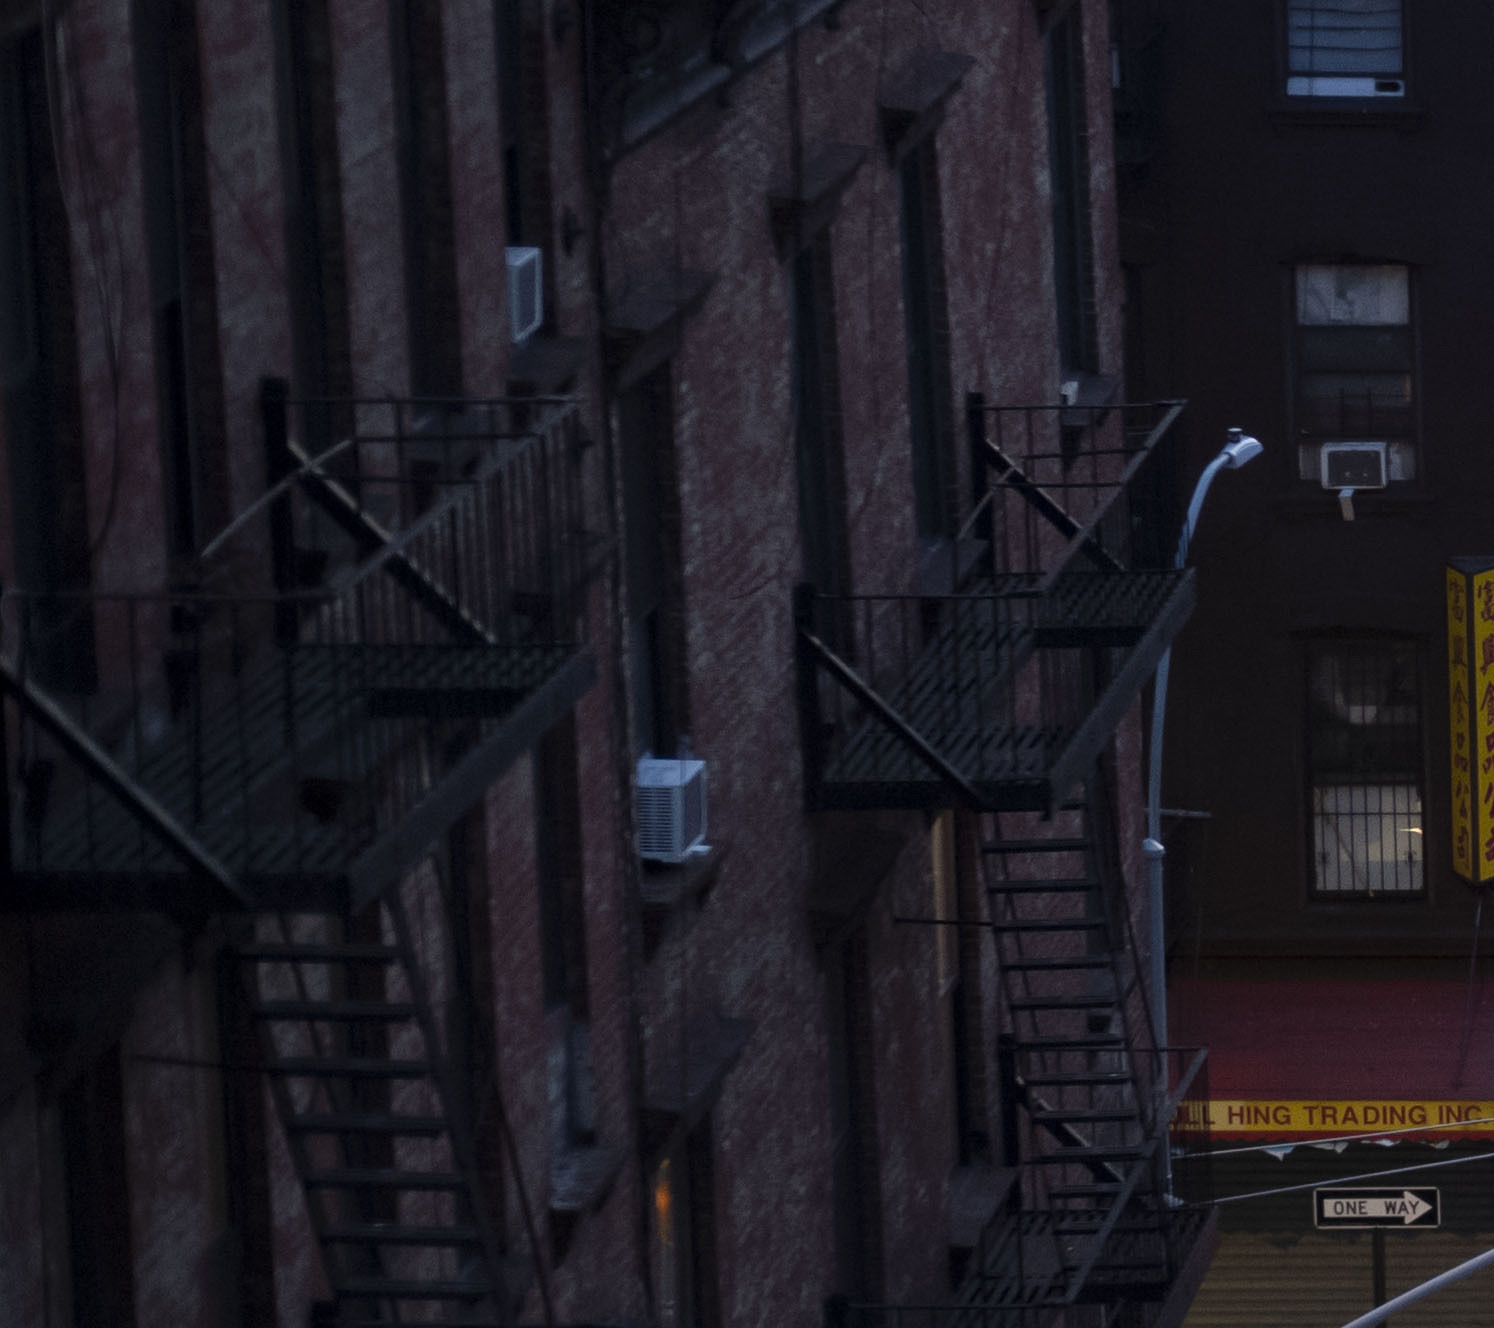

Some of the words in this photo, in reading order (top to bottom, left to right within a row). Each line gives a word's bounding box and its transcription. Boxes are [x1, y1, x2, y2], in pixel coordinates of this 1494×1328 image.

[1228, 1106, 1291, 1125] HING
[1303, 1105, 1427, 1125] TRADING
[1333, 1199, 1369, 1216] ONE
[1384, 1199, 1420, 1216] WAY
